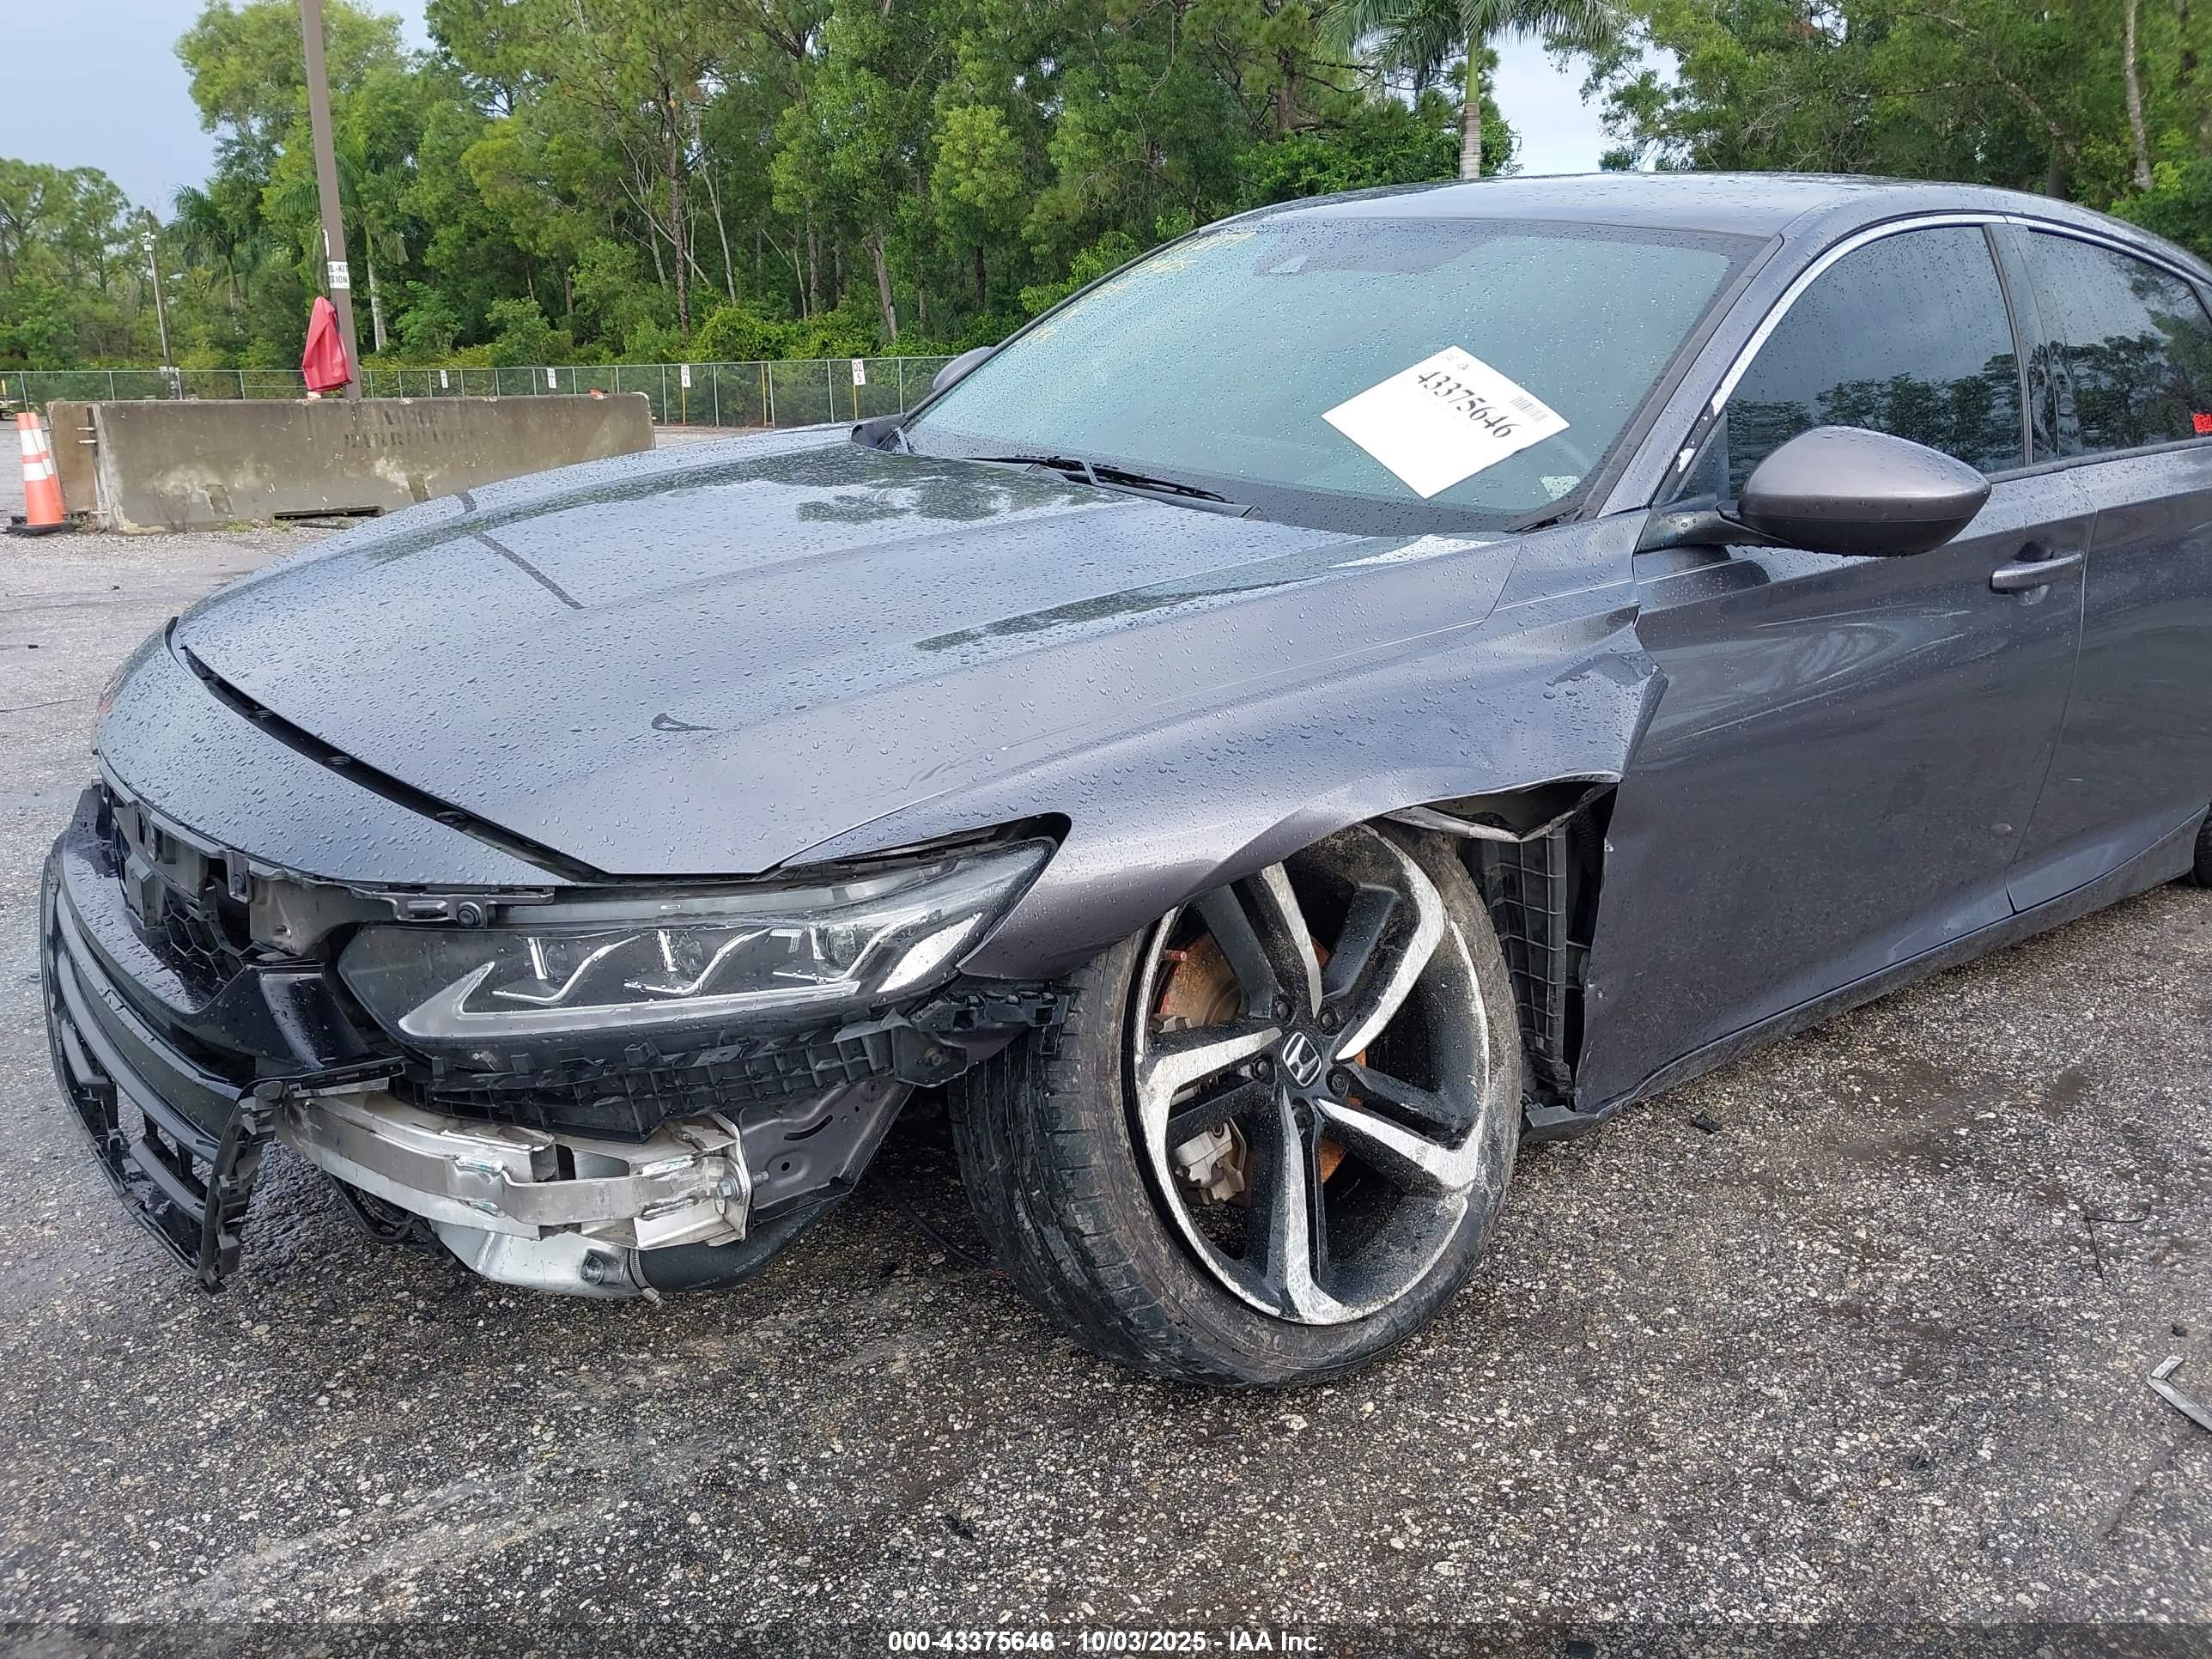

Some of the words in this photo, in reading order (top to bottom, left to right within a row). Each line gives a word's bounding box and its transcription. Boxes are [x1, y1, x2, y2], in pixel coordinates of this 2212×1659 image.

[853, 362, 863, 372] DZ
[857, 373, 862, 383] 5
[1418, 371, 1521, 438] 43375646
